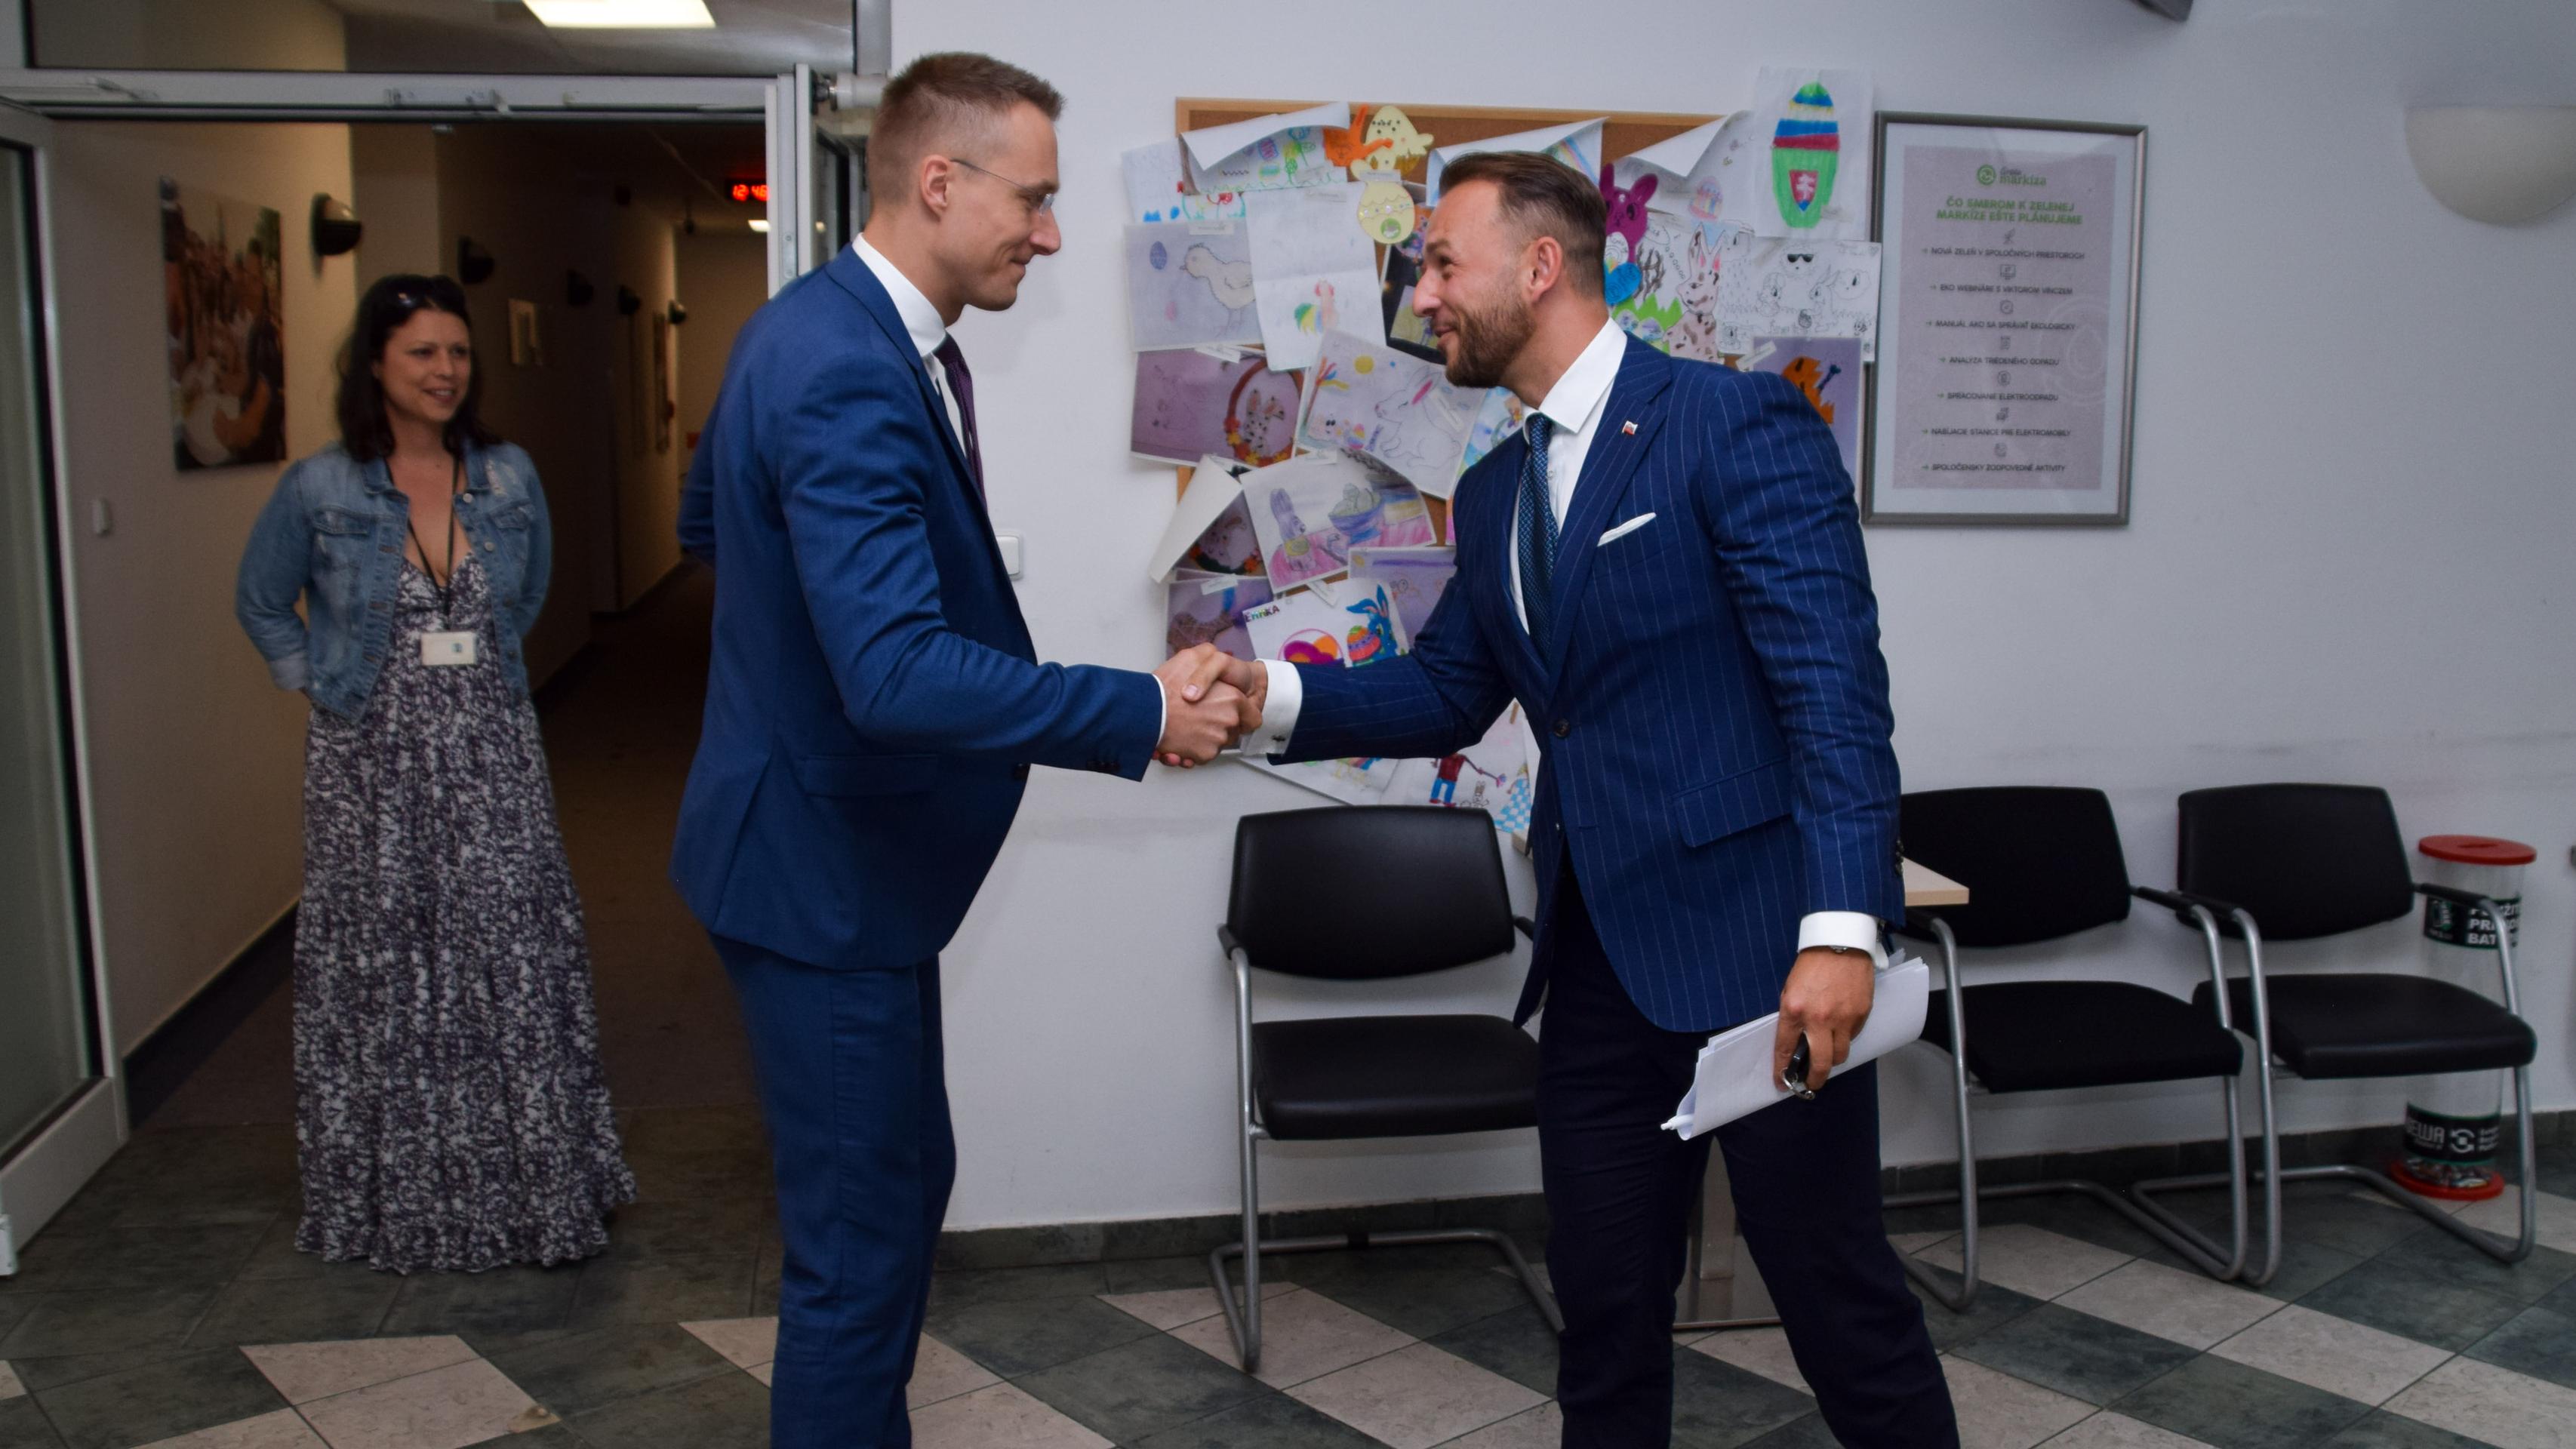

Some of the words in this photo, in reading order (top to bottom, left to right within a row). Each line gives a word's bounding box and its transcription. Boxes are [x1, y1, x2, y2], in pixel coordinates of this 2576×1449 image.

[1947, 195, 1963, 207] ČO
[1968, 198, 2015, 210] SMEROM
[2018, 200, 2027, 210] K
[2030, 201, 2074, 212] ZELENEJ
[1936, 208, 1986, 220] MARKÍZE
[1989, 209, 2015, 222] EŠTE
[2018, 211, 2083, 225] PLÁNUJEME
[1931, 247, 1953, 255] NOVÁ
